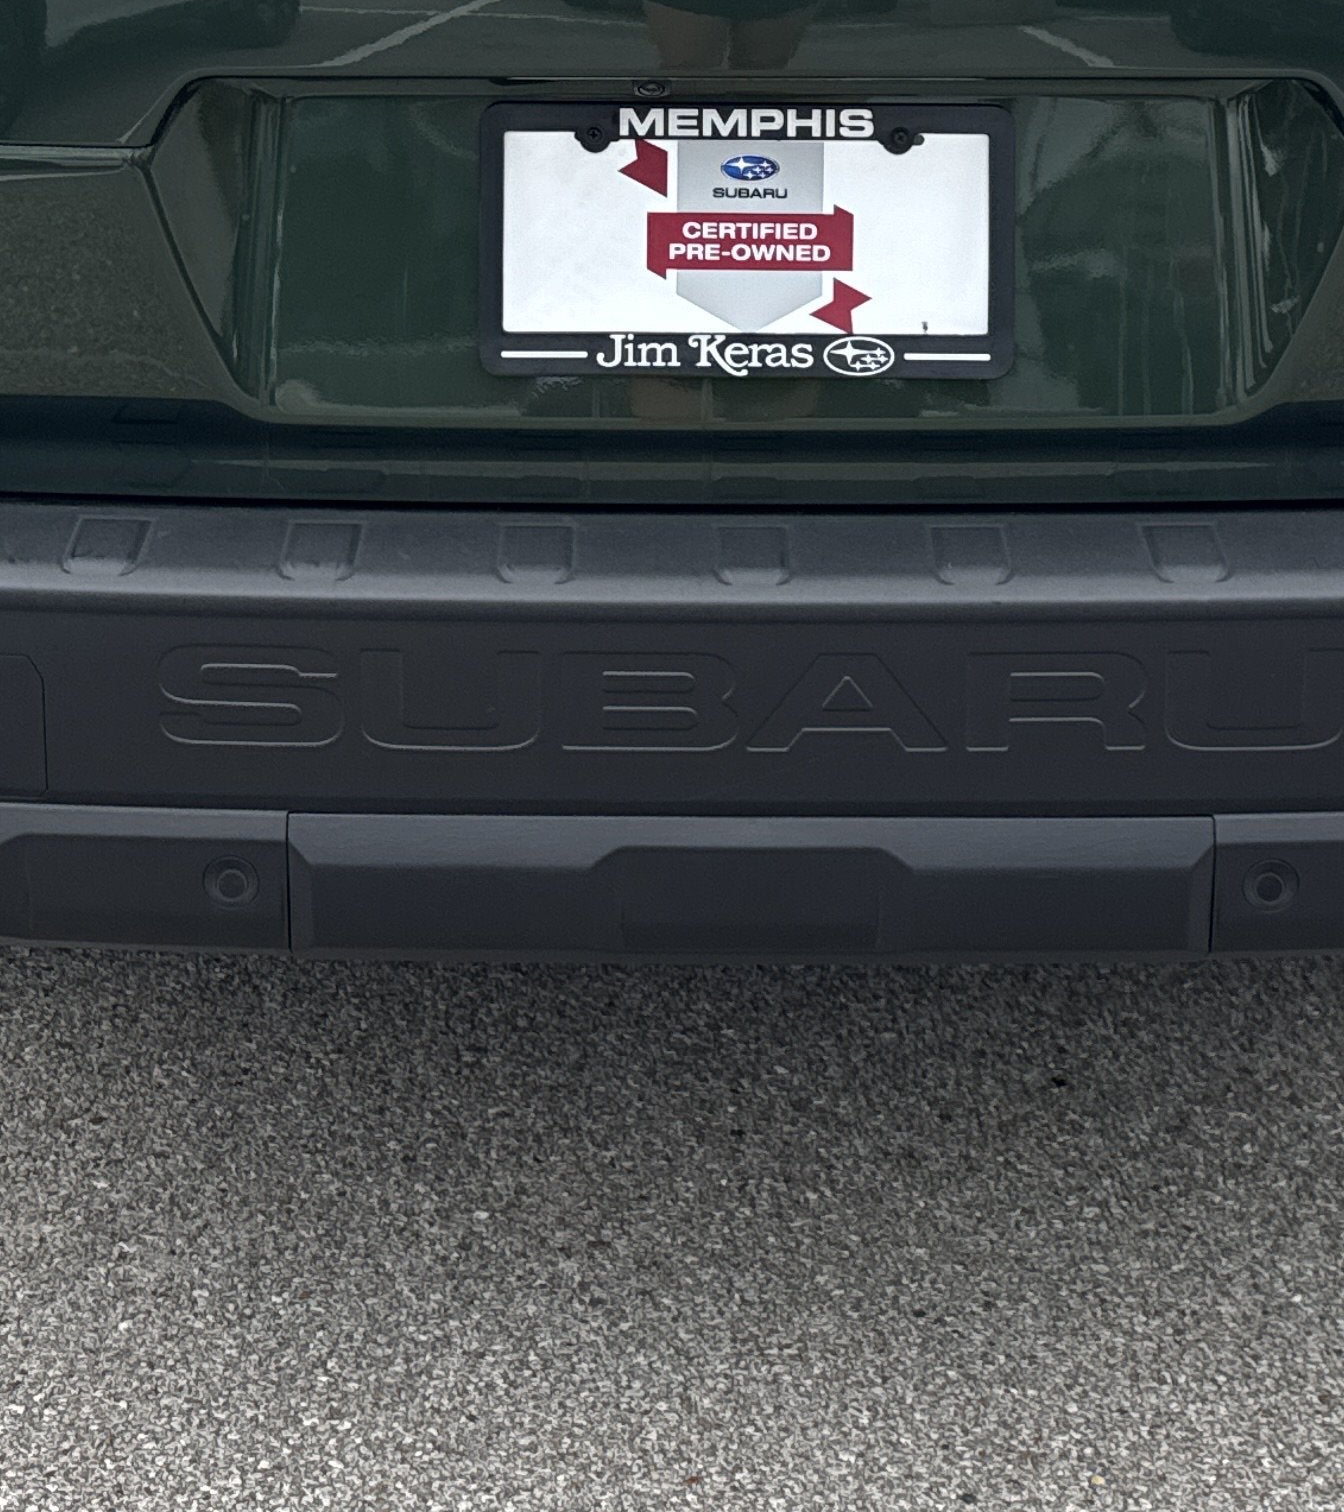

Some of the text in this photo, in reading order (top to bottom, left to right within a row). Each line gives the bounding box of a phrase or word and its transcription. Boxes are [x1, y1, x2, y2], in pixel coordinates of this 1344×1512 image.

[619, 107, 875, 138] MEMPHIS
[712, 187, 788, 199] SUBARU
[682, 222, 818, 240] CERTIFIED
[669, 243, 831, 262] PRE-OWNED
[596, 334, 814, 376] Jim Keras
